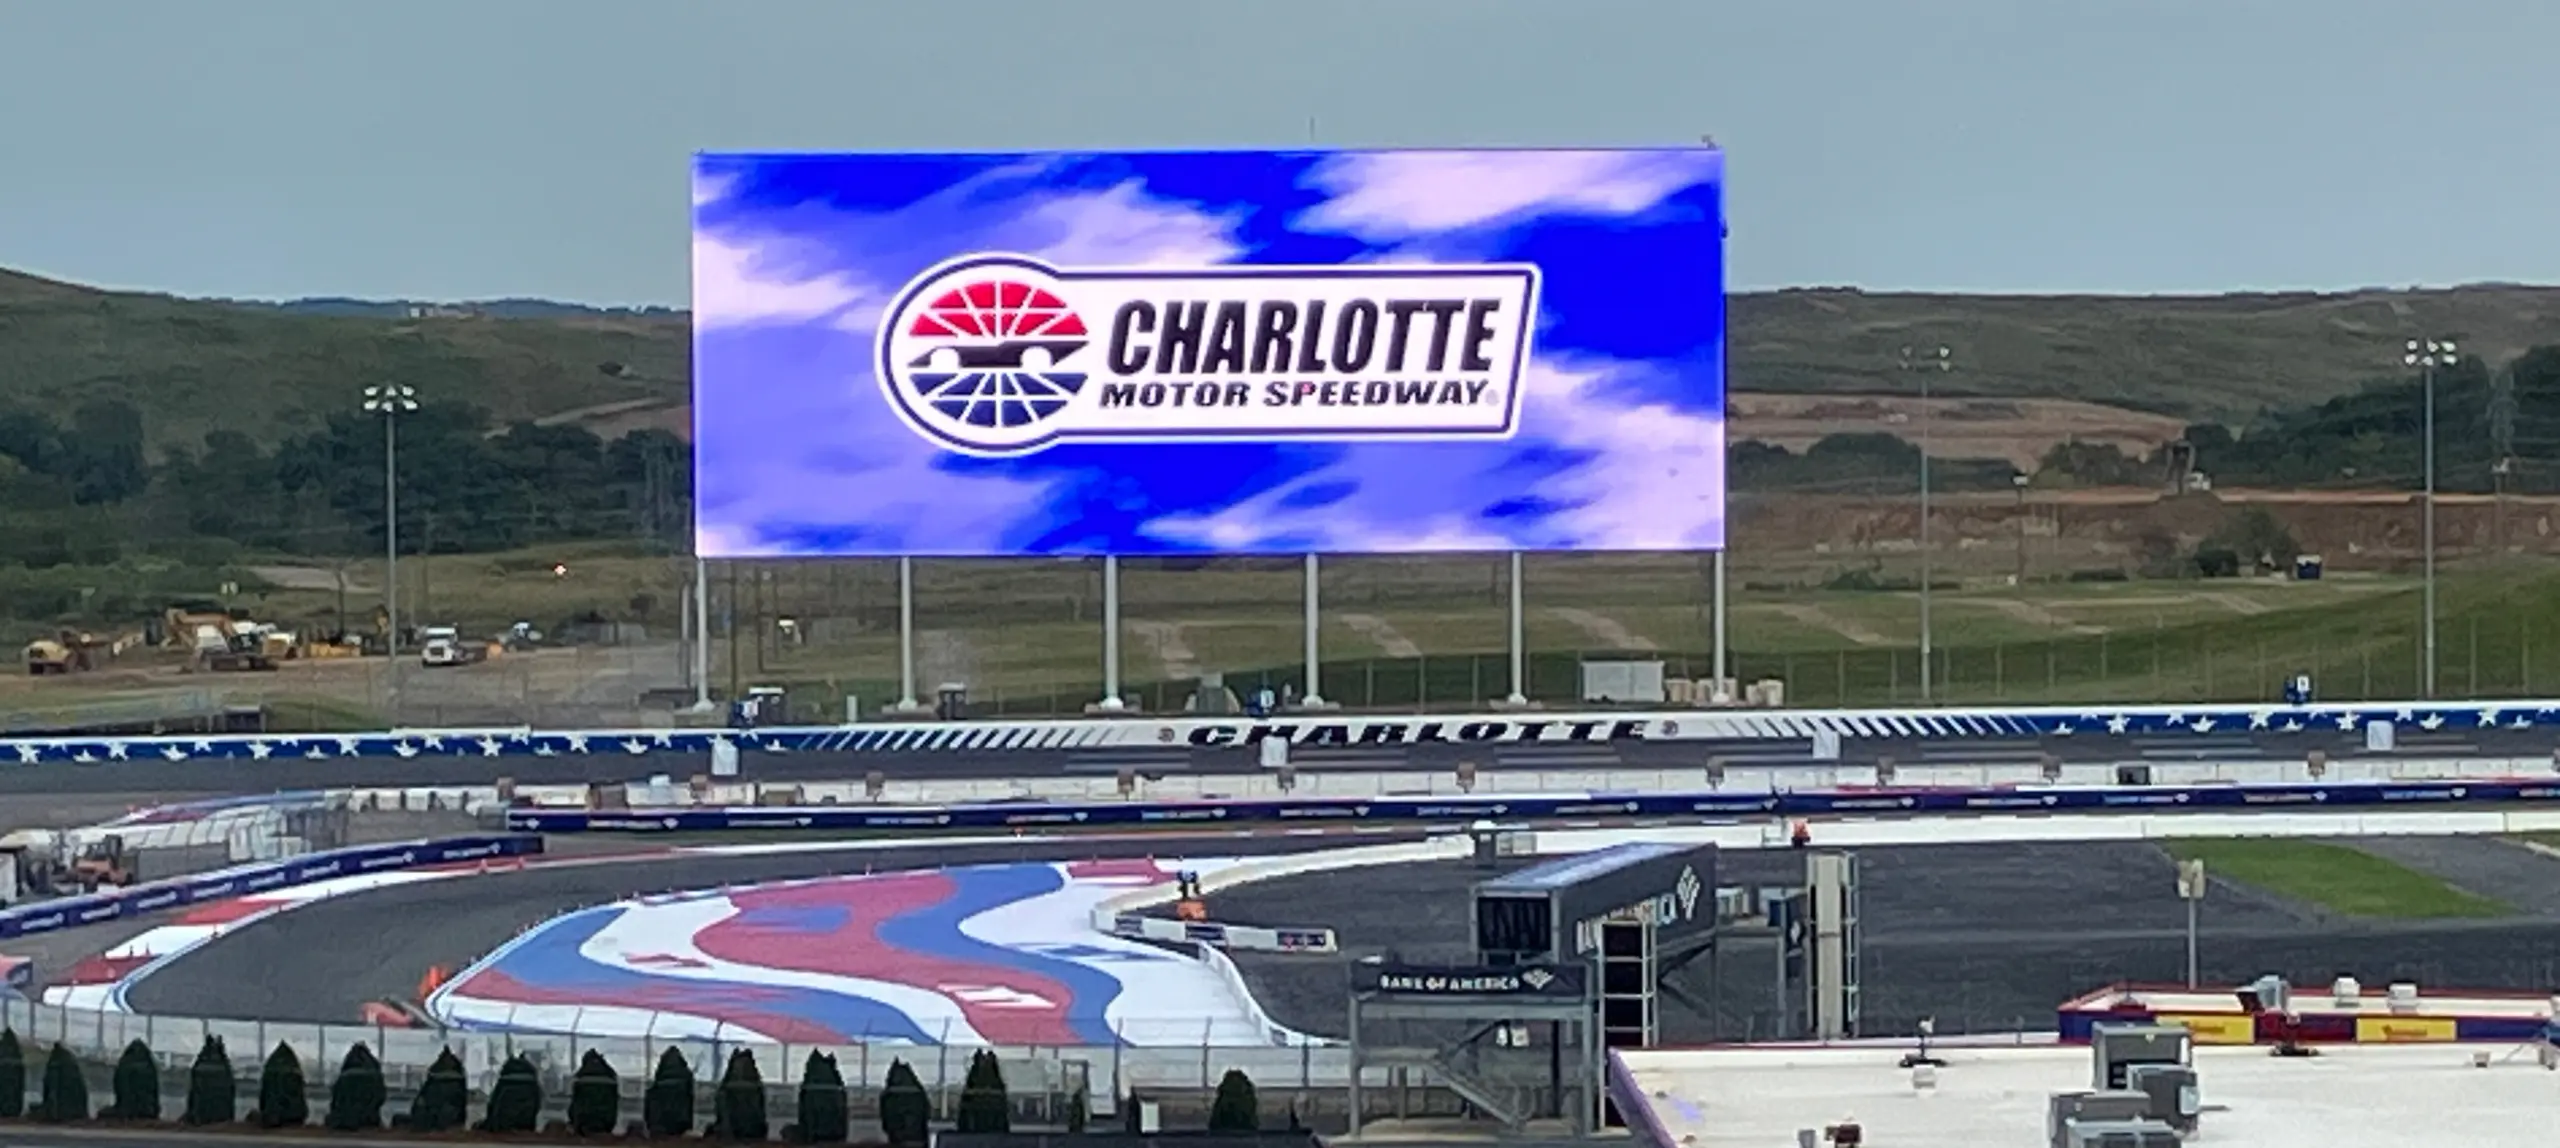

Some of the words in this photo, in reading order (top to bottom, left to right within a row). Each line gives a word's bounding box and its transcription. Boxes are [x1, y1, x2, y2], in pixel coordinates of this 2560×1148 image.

[1107, 298, 1501, 375] CHARLOTTE
[1099, 381, 1251, 409] MOTOR
[1263, 379, 1489, 408] SPEEDWAY
[1187, 719, 1652, 746] CHARLOTTE
[1380, 974, 1423, 989] BANK
[1426, 976, 1446, 990] OF
[1450, 976, 1520, 990] AMERICA
